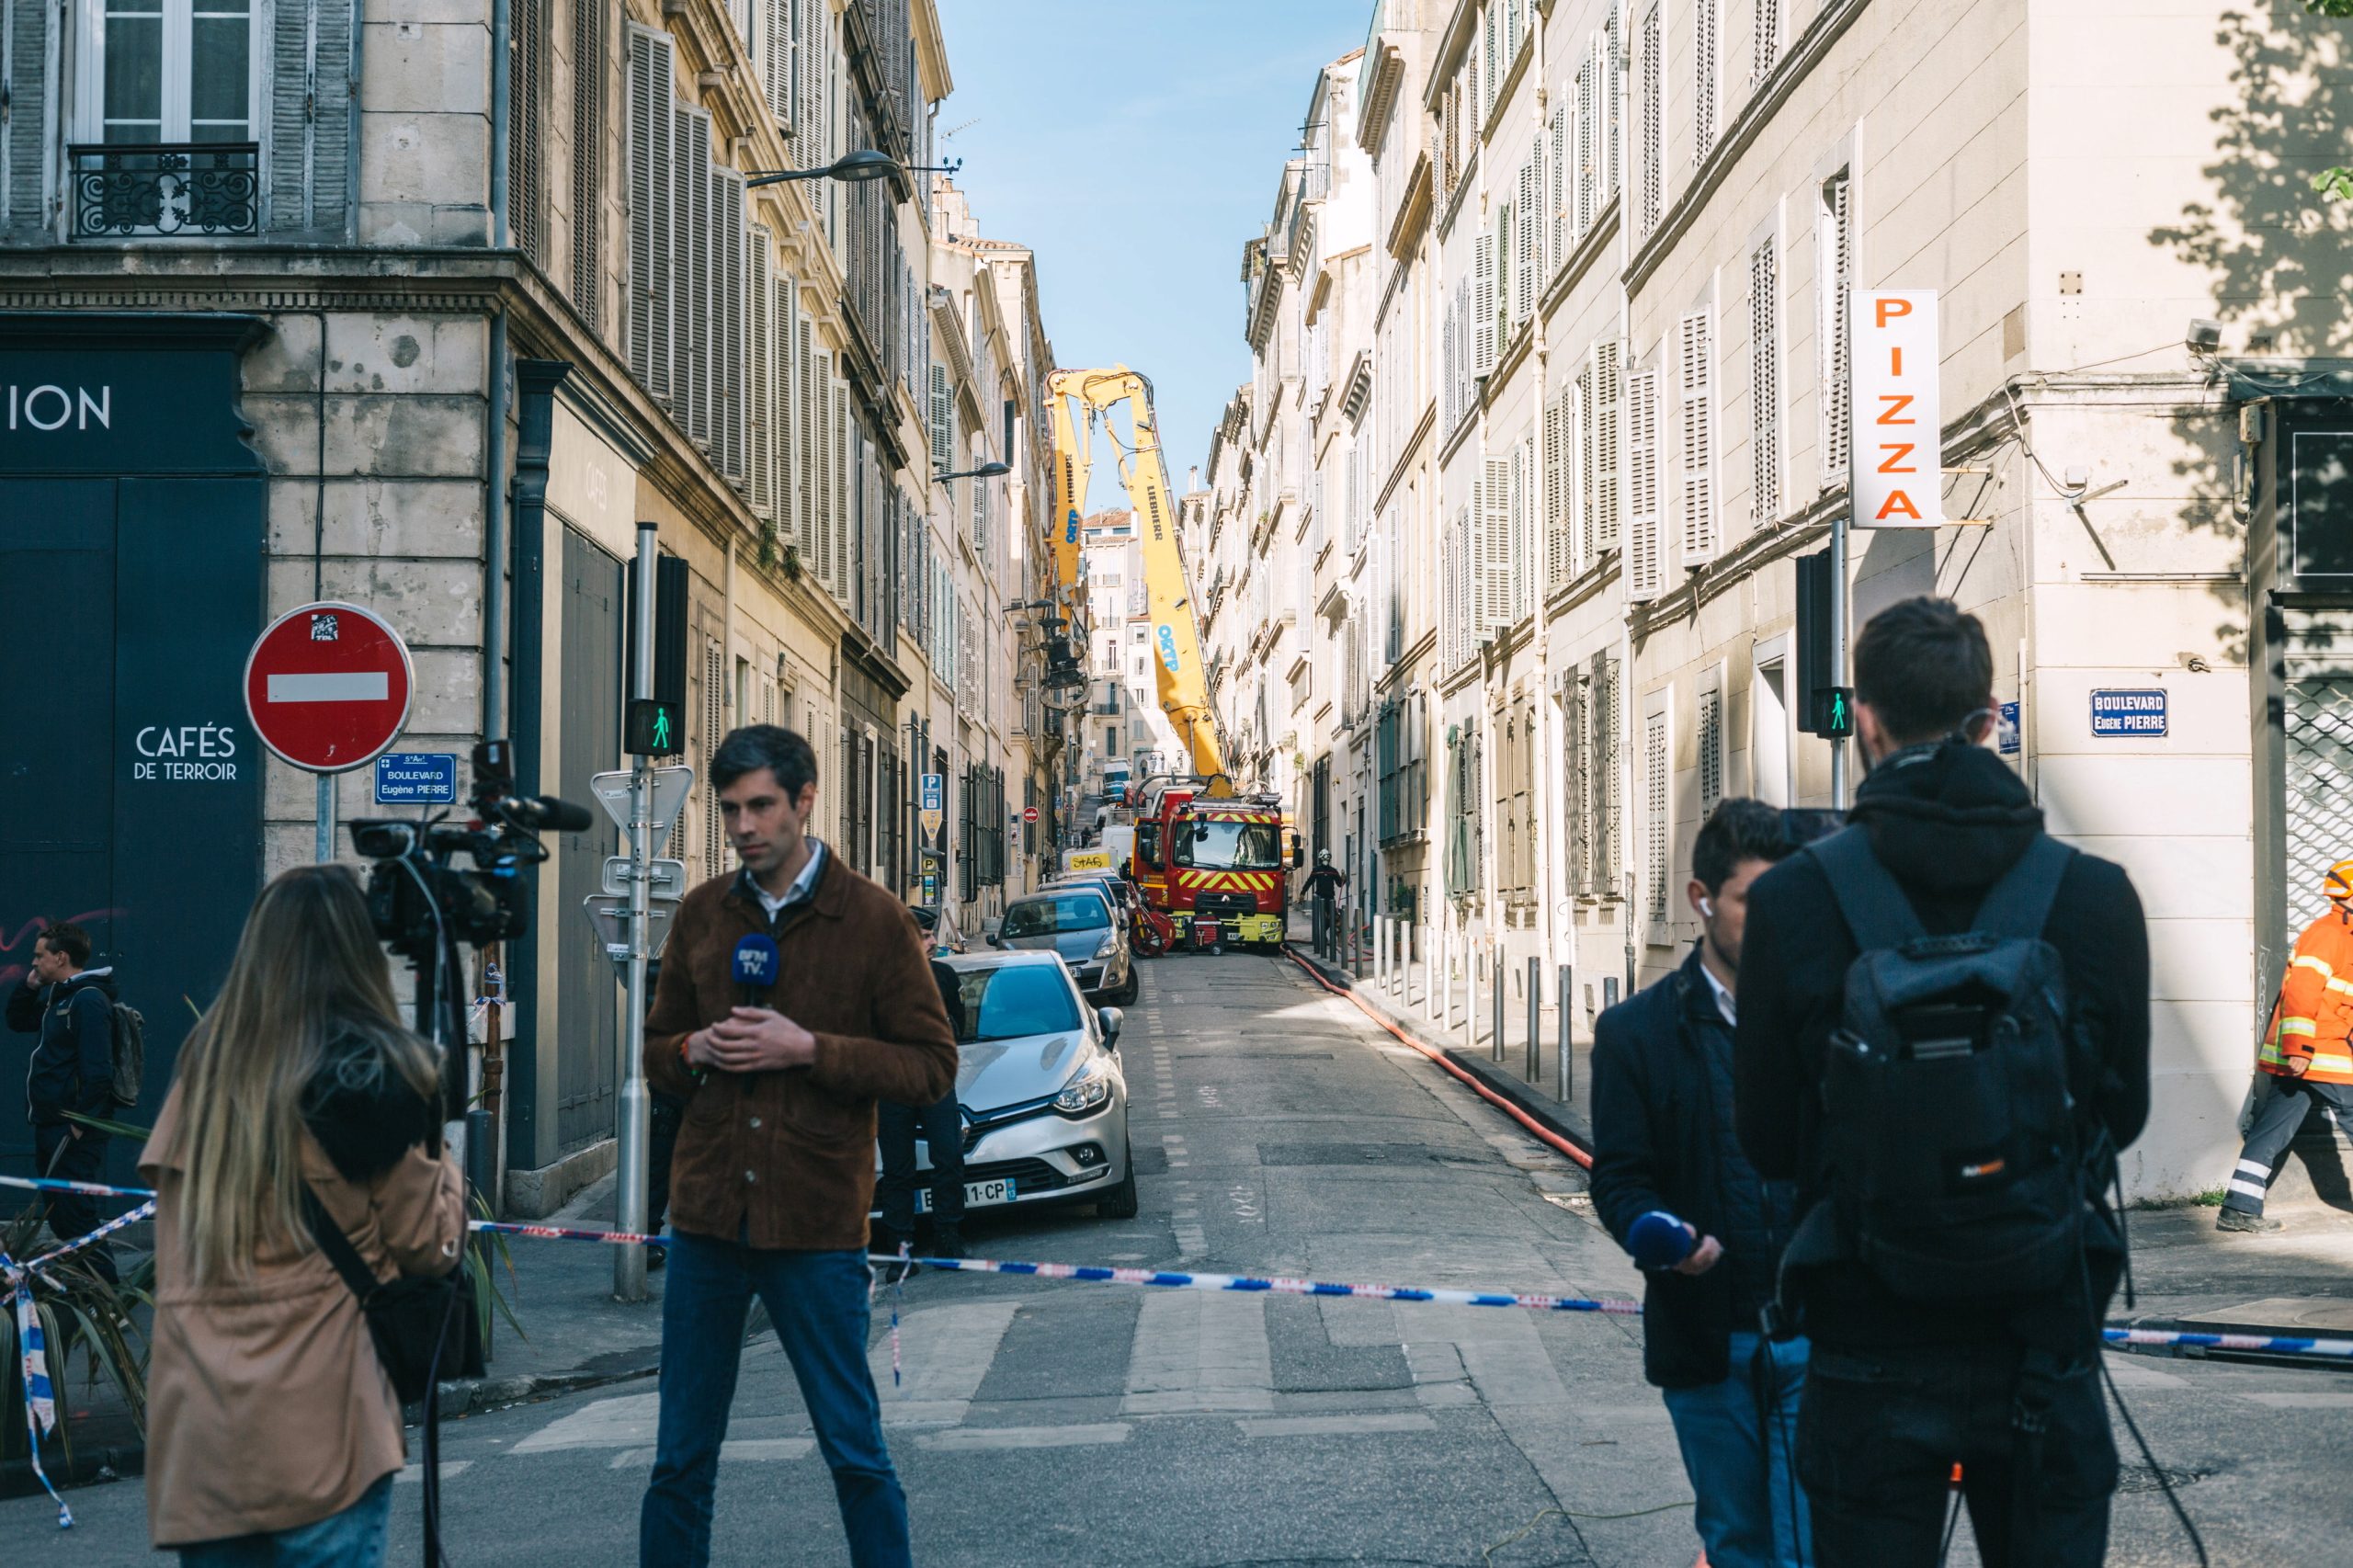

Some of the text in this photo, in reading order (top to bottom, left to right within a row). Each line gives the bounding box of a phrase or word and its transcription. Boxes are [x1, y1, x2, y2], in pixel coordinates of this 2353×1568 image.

[0, 384, 110, 431] ION
[1875, 299, 1923, 520] PIZZA
[1065, 453, 1075, 504] LIEBHERR
[1065, 508, 1079, 544] ORTP
[1147, 485, 1163, 541] LIEBHERR
[1158, 624, 1179, 672] ORTP
[2095, 696, 2164, 710] BOULEVARD
[2124, 715, 2165, 730] PIERRE
[136, 721, 236, 757] CAFÉS
[134, 762, 237, 780] DE TERROIR
[387, 771, 444, 780] BOULEVARD
[927, 776, 937, 789] P
[381, 784, 449, 796] Eugène PIERRE
[925, 859, 934, 869] P
